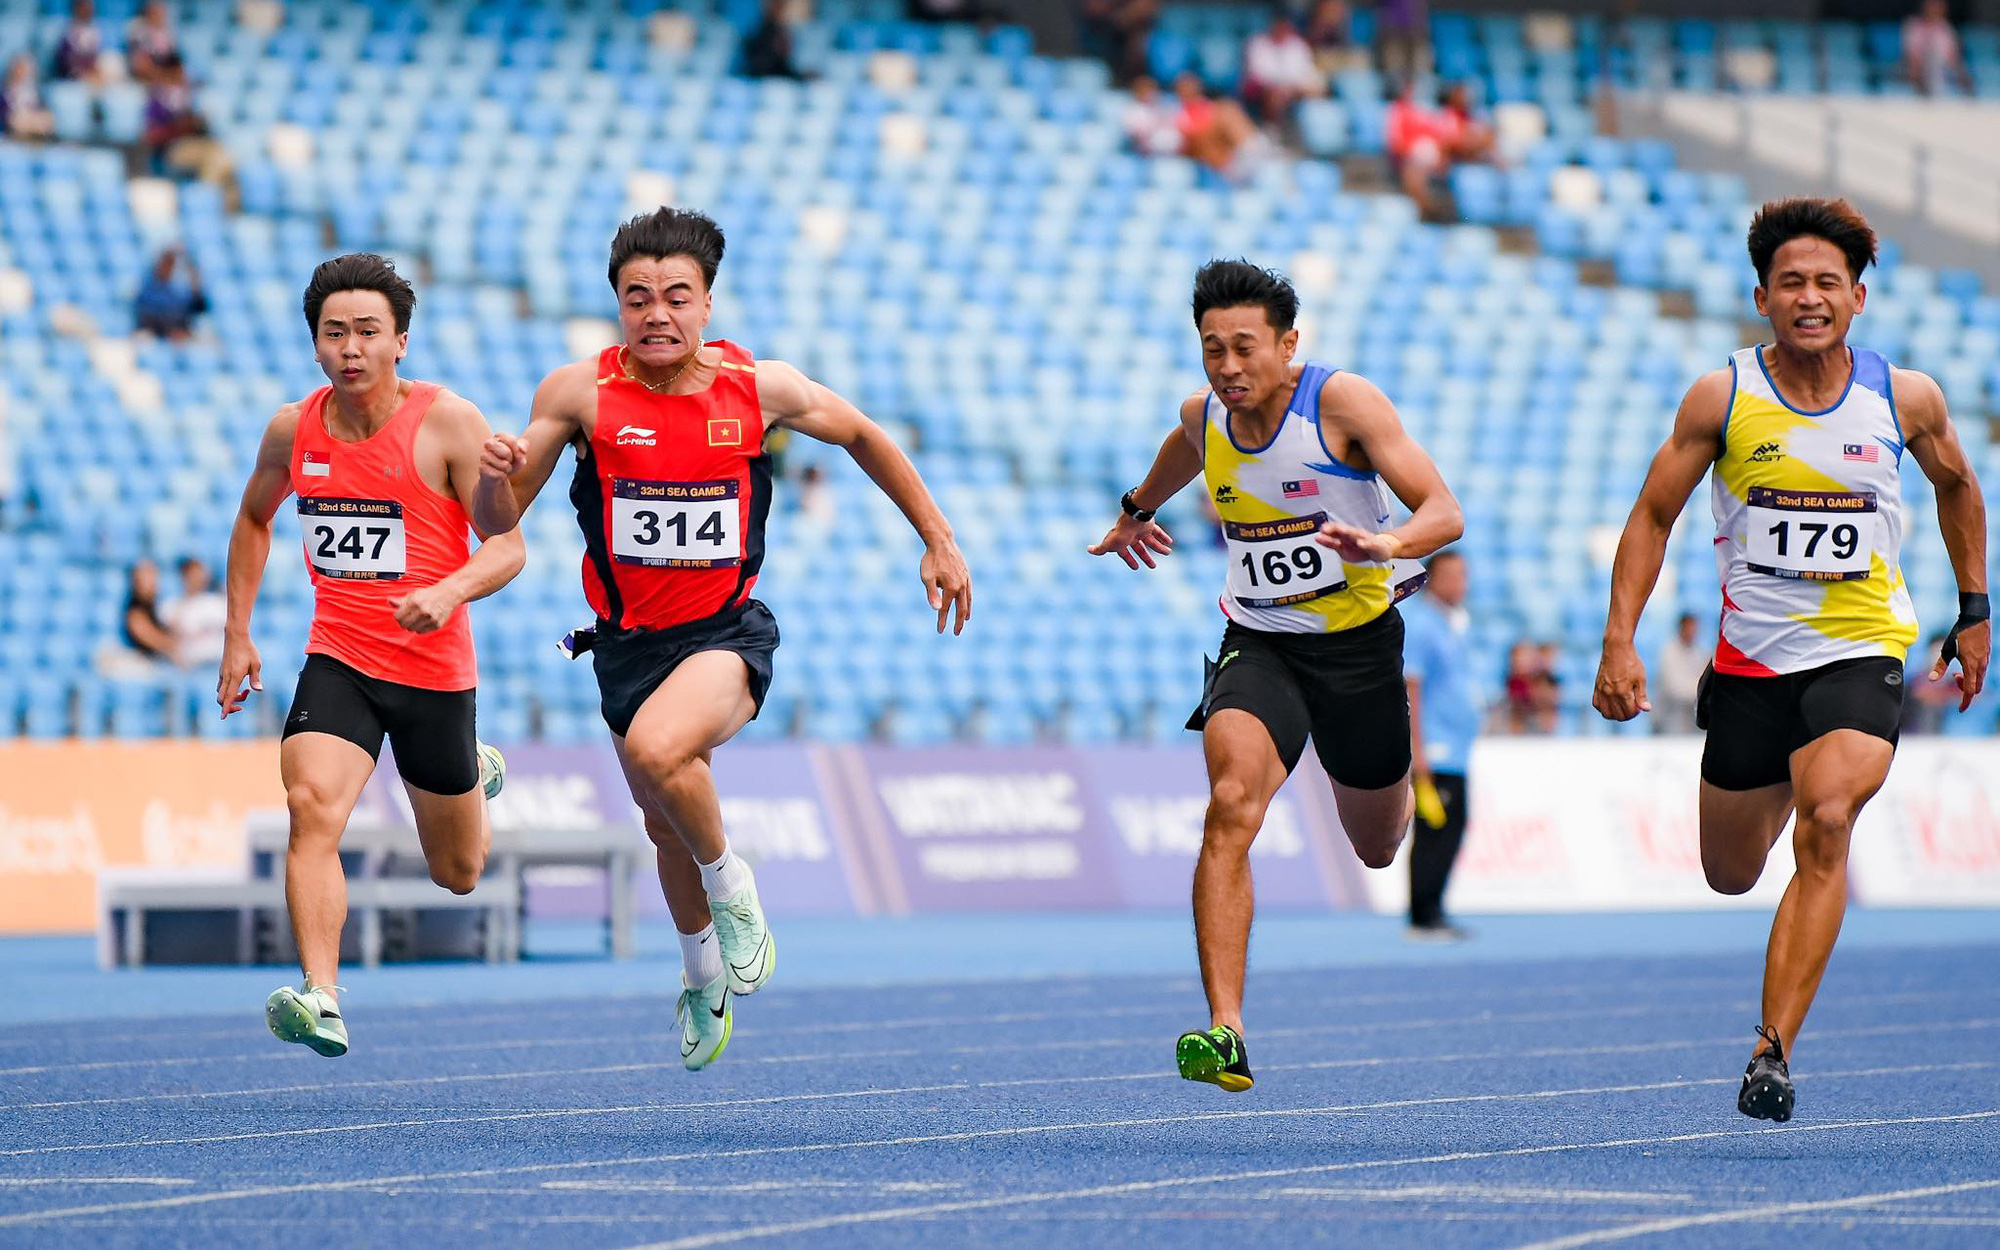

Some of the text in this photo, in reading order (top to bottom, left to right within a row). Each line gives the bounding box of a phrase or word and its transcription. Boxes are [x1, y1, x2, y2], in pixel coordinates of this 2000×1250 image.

[641, 486, 726, 497] 32nd SEA GAMES
[1776, 495, 1865, 508] 32nd SEA GAMES
[318, 502, 391, 513] 32nd SEA GAMES
[632, 510, 726, 547] 314
[1256, 526, 1276, 537] SEA
[1277, 520, 1314, 534] GAMES
[1768, 520, 1860, 559] 179
[314, 525, 391, 560] 247
[1241, 546, 1322, 587] 169
